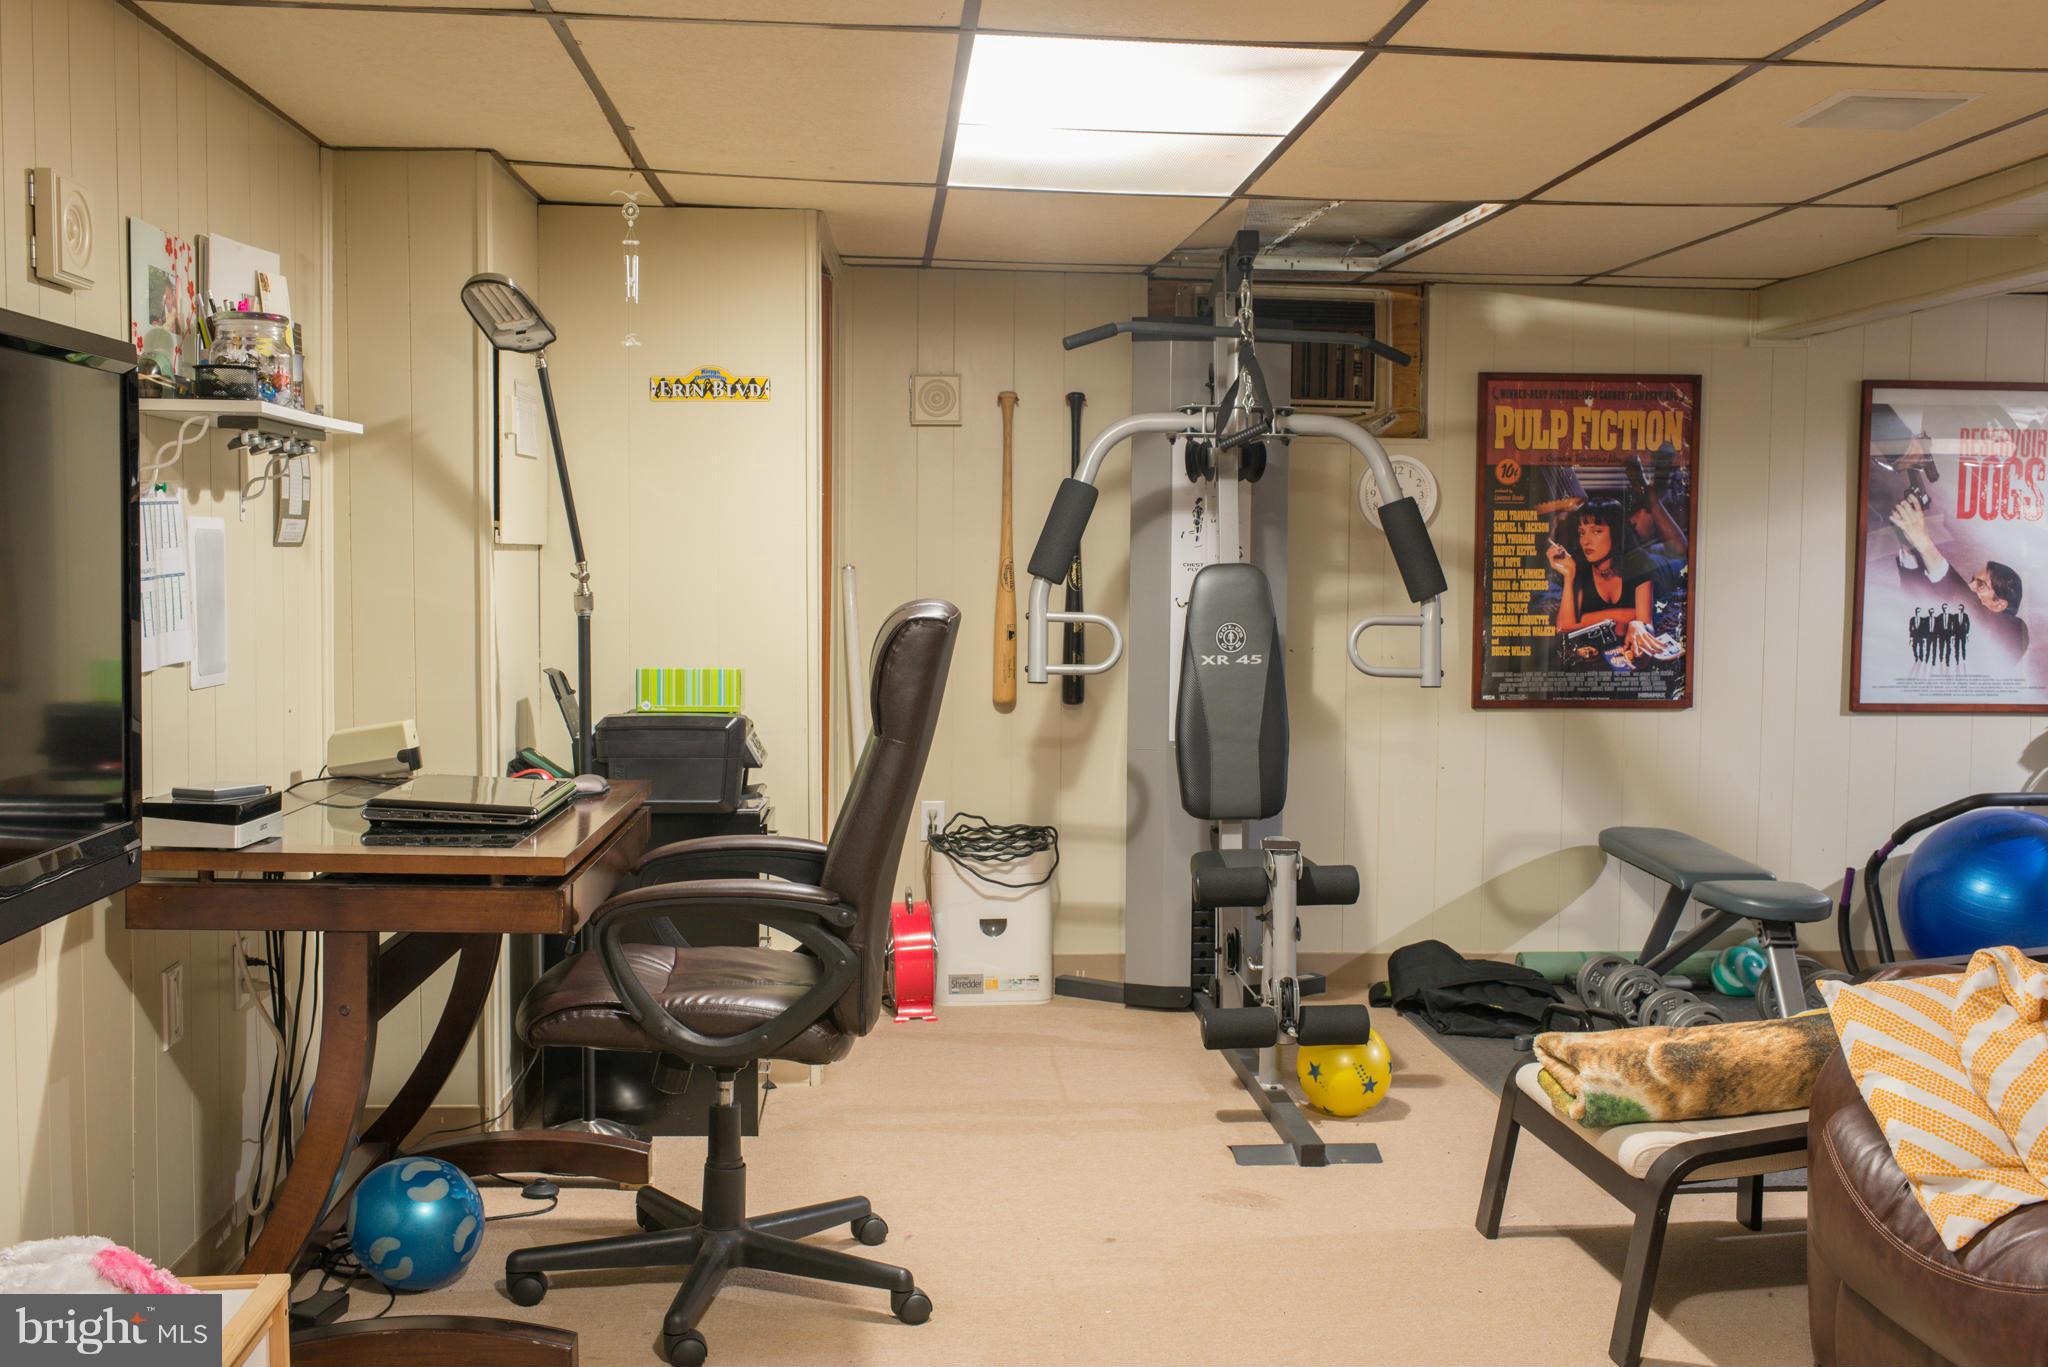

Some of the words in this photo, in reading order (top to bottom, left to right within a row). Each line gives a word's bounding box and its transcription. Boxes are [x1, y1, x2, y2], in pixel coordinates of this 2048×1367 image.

[660, 380, 705, 398] ERIN
[713, 380, 761, 398] BLVD
[1494, 405, 1568, 450] PULP
[1572, 406, 1684, 451] FICTION
[1960, 427, 2048, 458] RESERVOIR
[1956, 455, 2046, 521] DOGS
[1201, 655, 1230, 666] XR
[1235, 654, 1262, 665] 45
[951, 979, 982, 989] Shredder
